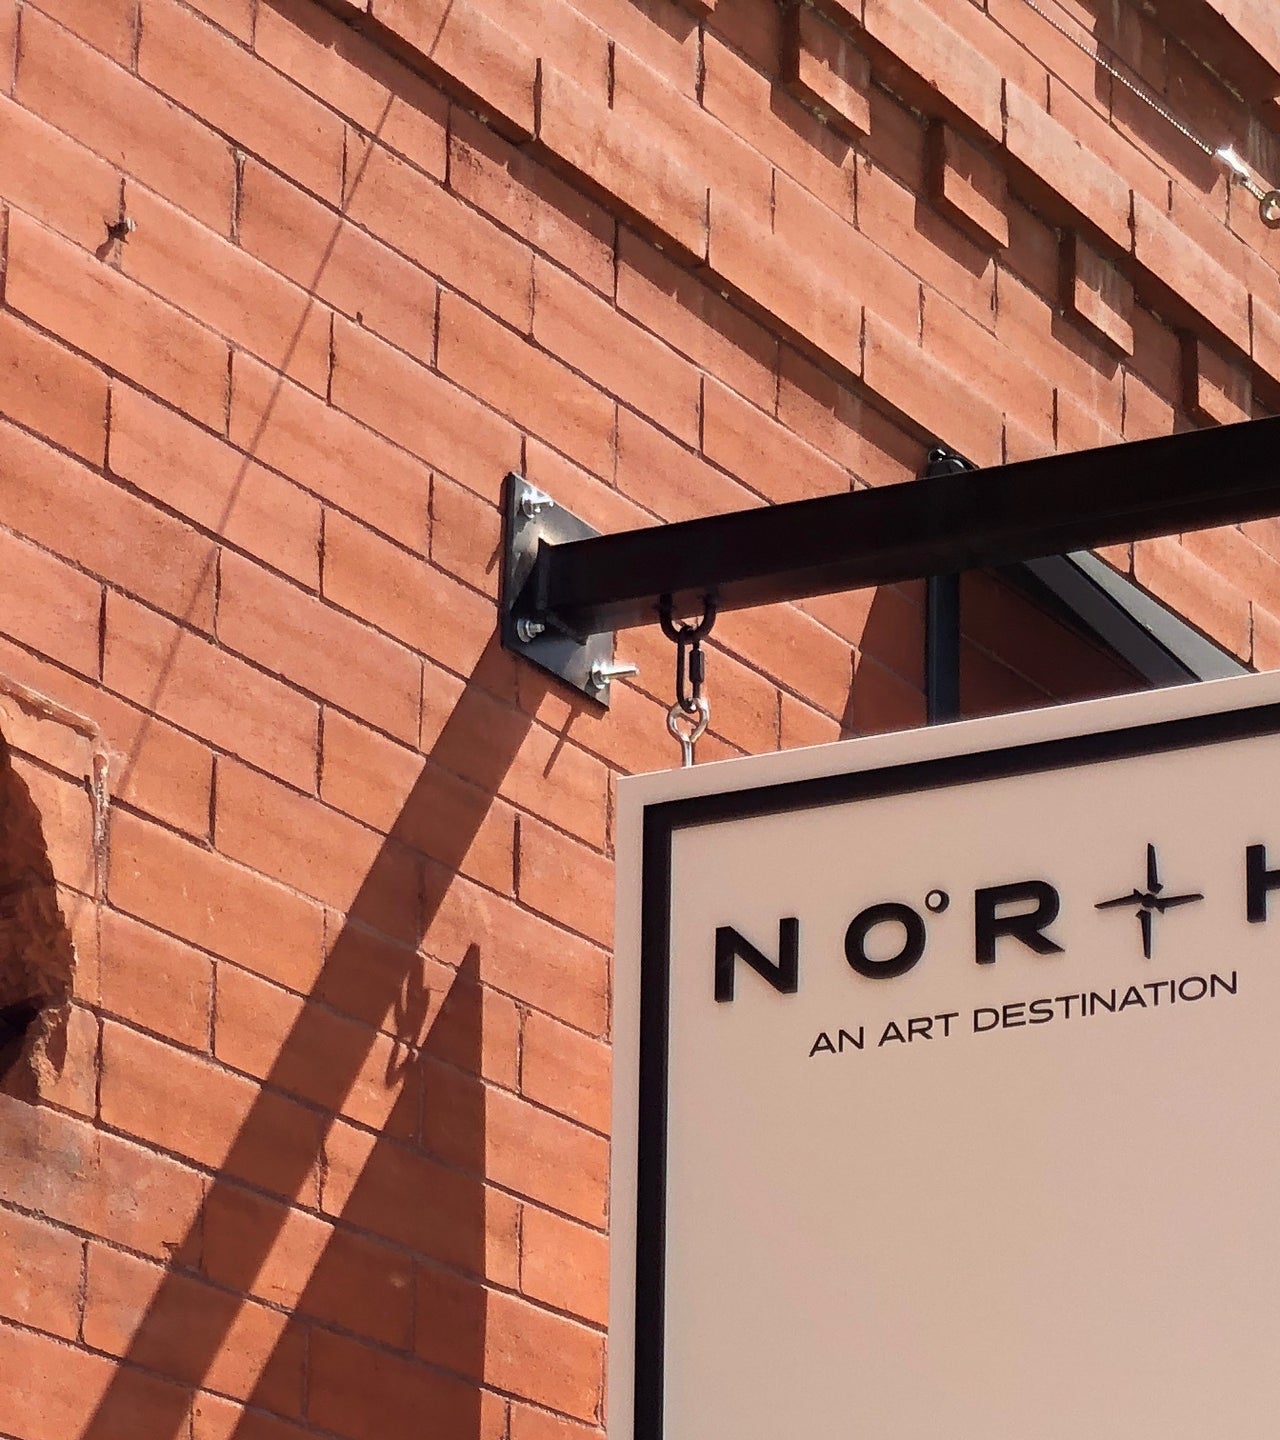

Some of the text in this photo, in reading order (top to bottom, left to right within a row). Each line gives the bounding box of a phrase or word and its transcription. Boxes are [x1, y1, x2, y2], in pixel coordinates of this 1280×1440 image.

[808, 971, 1238, 1058] AN ART DESTINATION
